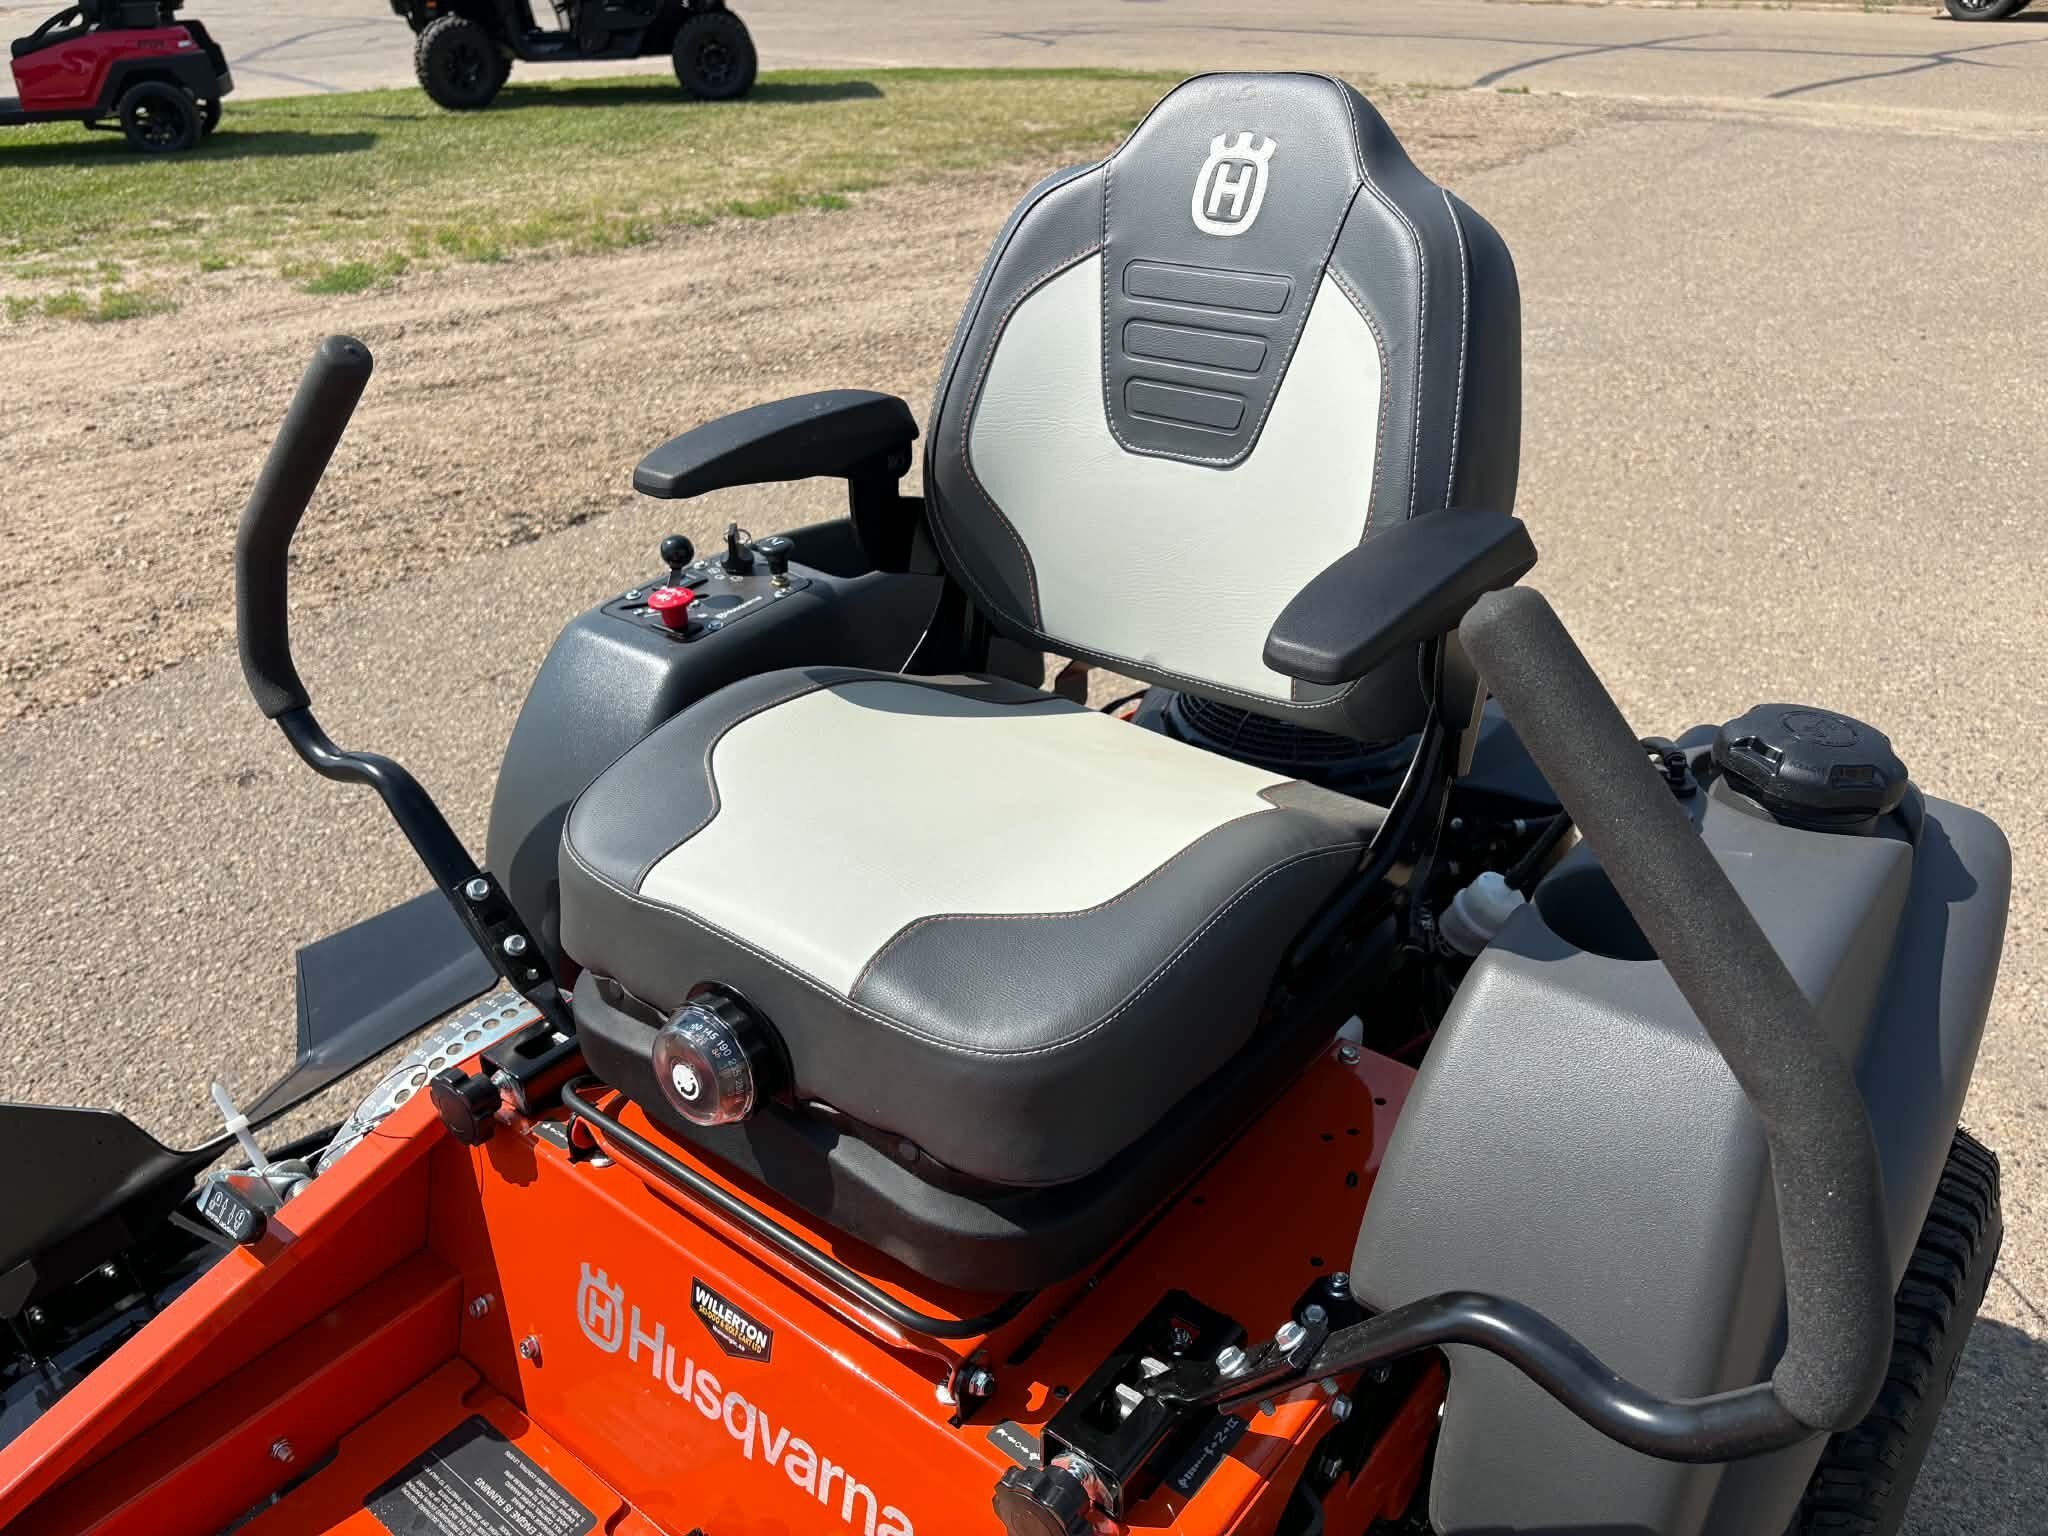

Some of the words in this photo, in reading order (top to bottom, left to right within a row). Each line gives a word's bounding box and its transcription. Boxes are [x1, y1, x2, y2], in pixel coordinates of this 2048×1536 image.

[716, 1040, 733, 1057] 190
[696, 1286, 767, 1349] WILLERTON
[739, 1331, 752, 1346] CART
[752, 1342, 762, 1354] LTD
[474, 1477, 506, 1506] RUNNING
[503, 1503, 513, 1513] IS
[509, 1510, 536, 1535] ENGINE
